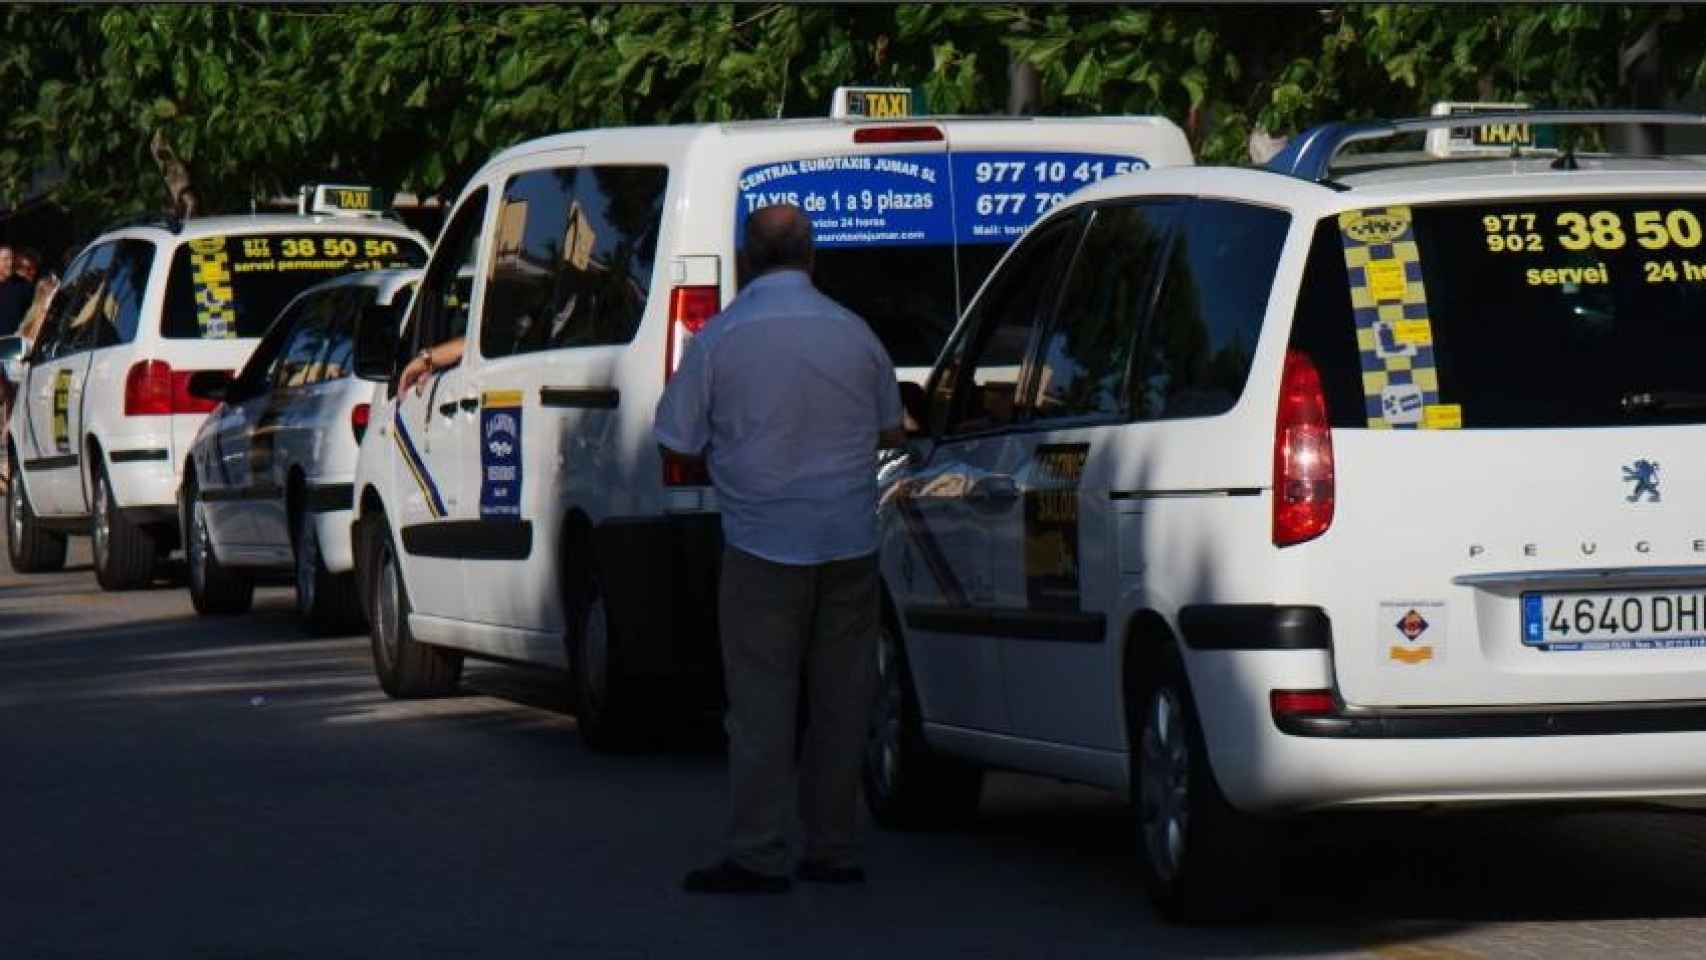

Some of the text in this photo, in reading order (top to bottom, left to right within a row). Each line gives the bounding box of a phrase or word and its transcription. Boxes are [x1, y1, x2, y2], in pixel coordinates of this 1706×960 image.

[865, 93, 907, 118] TAXI
[1480, 122, 1529, 143] TAXI
[739, 163, 797, 191] CENTRAL
[801, 158, 871, 173] EUROTAXIS
[874, 159, 918, 177] JUMAR
[975, 162, 1025, 183] 977
[1035, 162, 1065, 182] 10
[1073, 162, 1103, 183] 41
[337, 191, 369, 209] TAXI
[804, 191, 826, 212] de
[832, 191, 840, 211] 1
[847, 195, 857, 210] a
[861, 190, 873, 210] 9
[878, 190, 934, 214] plazas
[976, 193, 1025, 216] 677
[1484, 213, 1537, 232] 977
[1556, 209, 1702, 250] 38 50
[281, 239, 316, 258] 38
[323, 239, 357, 258] 50
[1487, 233, 1544, 252] 902
[1527, 263, 1609, 286] servei
[1644, 261, 1677, 282] 24
[1550, 595, 1706, 635] 4640 DH
